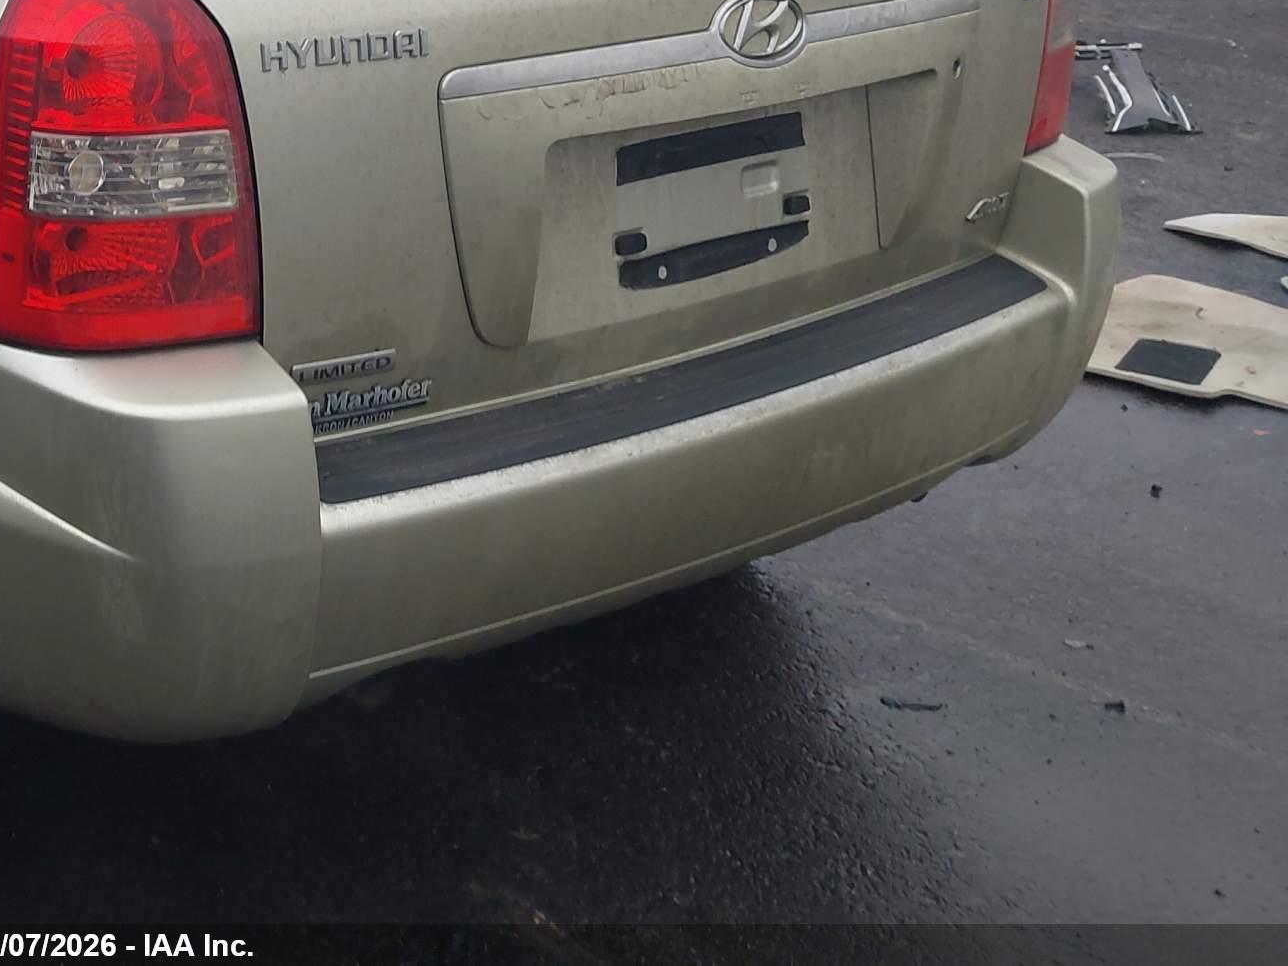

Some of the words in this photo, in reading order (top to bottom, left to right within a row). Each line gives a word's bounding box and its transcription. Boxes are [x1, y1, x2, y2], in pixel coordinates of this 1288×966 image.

[260, 27, 429, 73] HYUNDAI
[298, 356, 392, 382] LIMITED
[323, 379, 432, 416] Marhofer
[313, 410, 394, 434] KRON/CANTON
